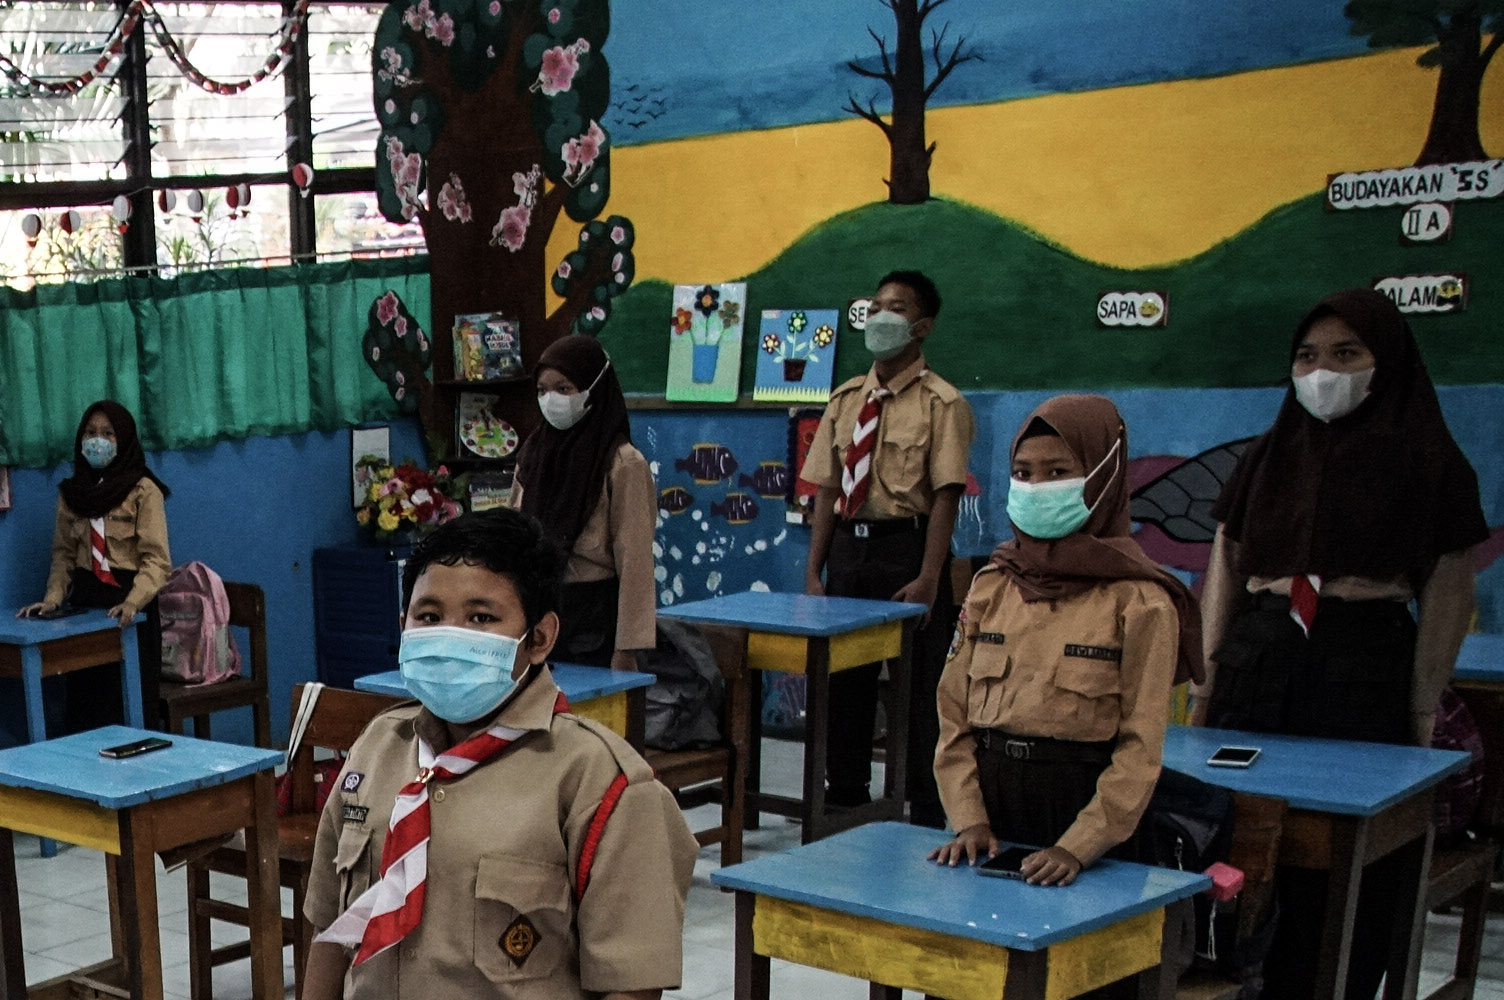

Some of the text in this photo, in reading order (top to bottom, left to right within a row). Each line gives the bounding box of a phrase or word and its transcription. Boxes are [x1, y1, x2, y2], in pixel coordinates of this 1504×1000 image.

[1331, 173, 1444, 203] BUDAYAKAN
[1426, 211, 1440, 232] A
[1377, 285, 1437, 307] ALAM
[849, 306, 869, 324] SE
[1098, 299, 1137, 319] SAPA
